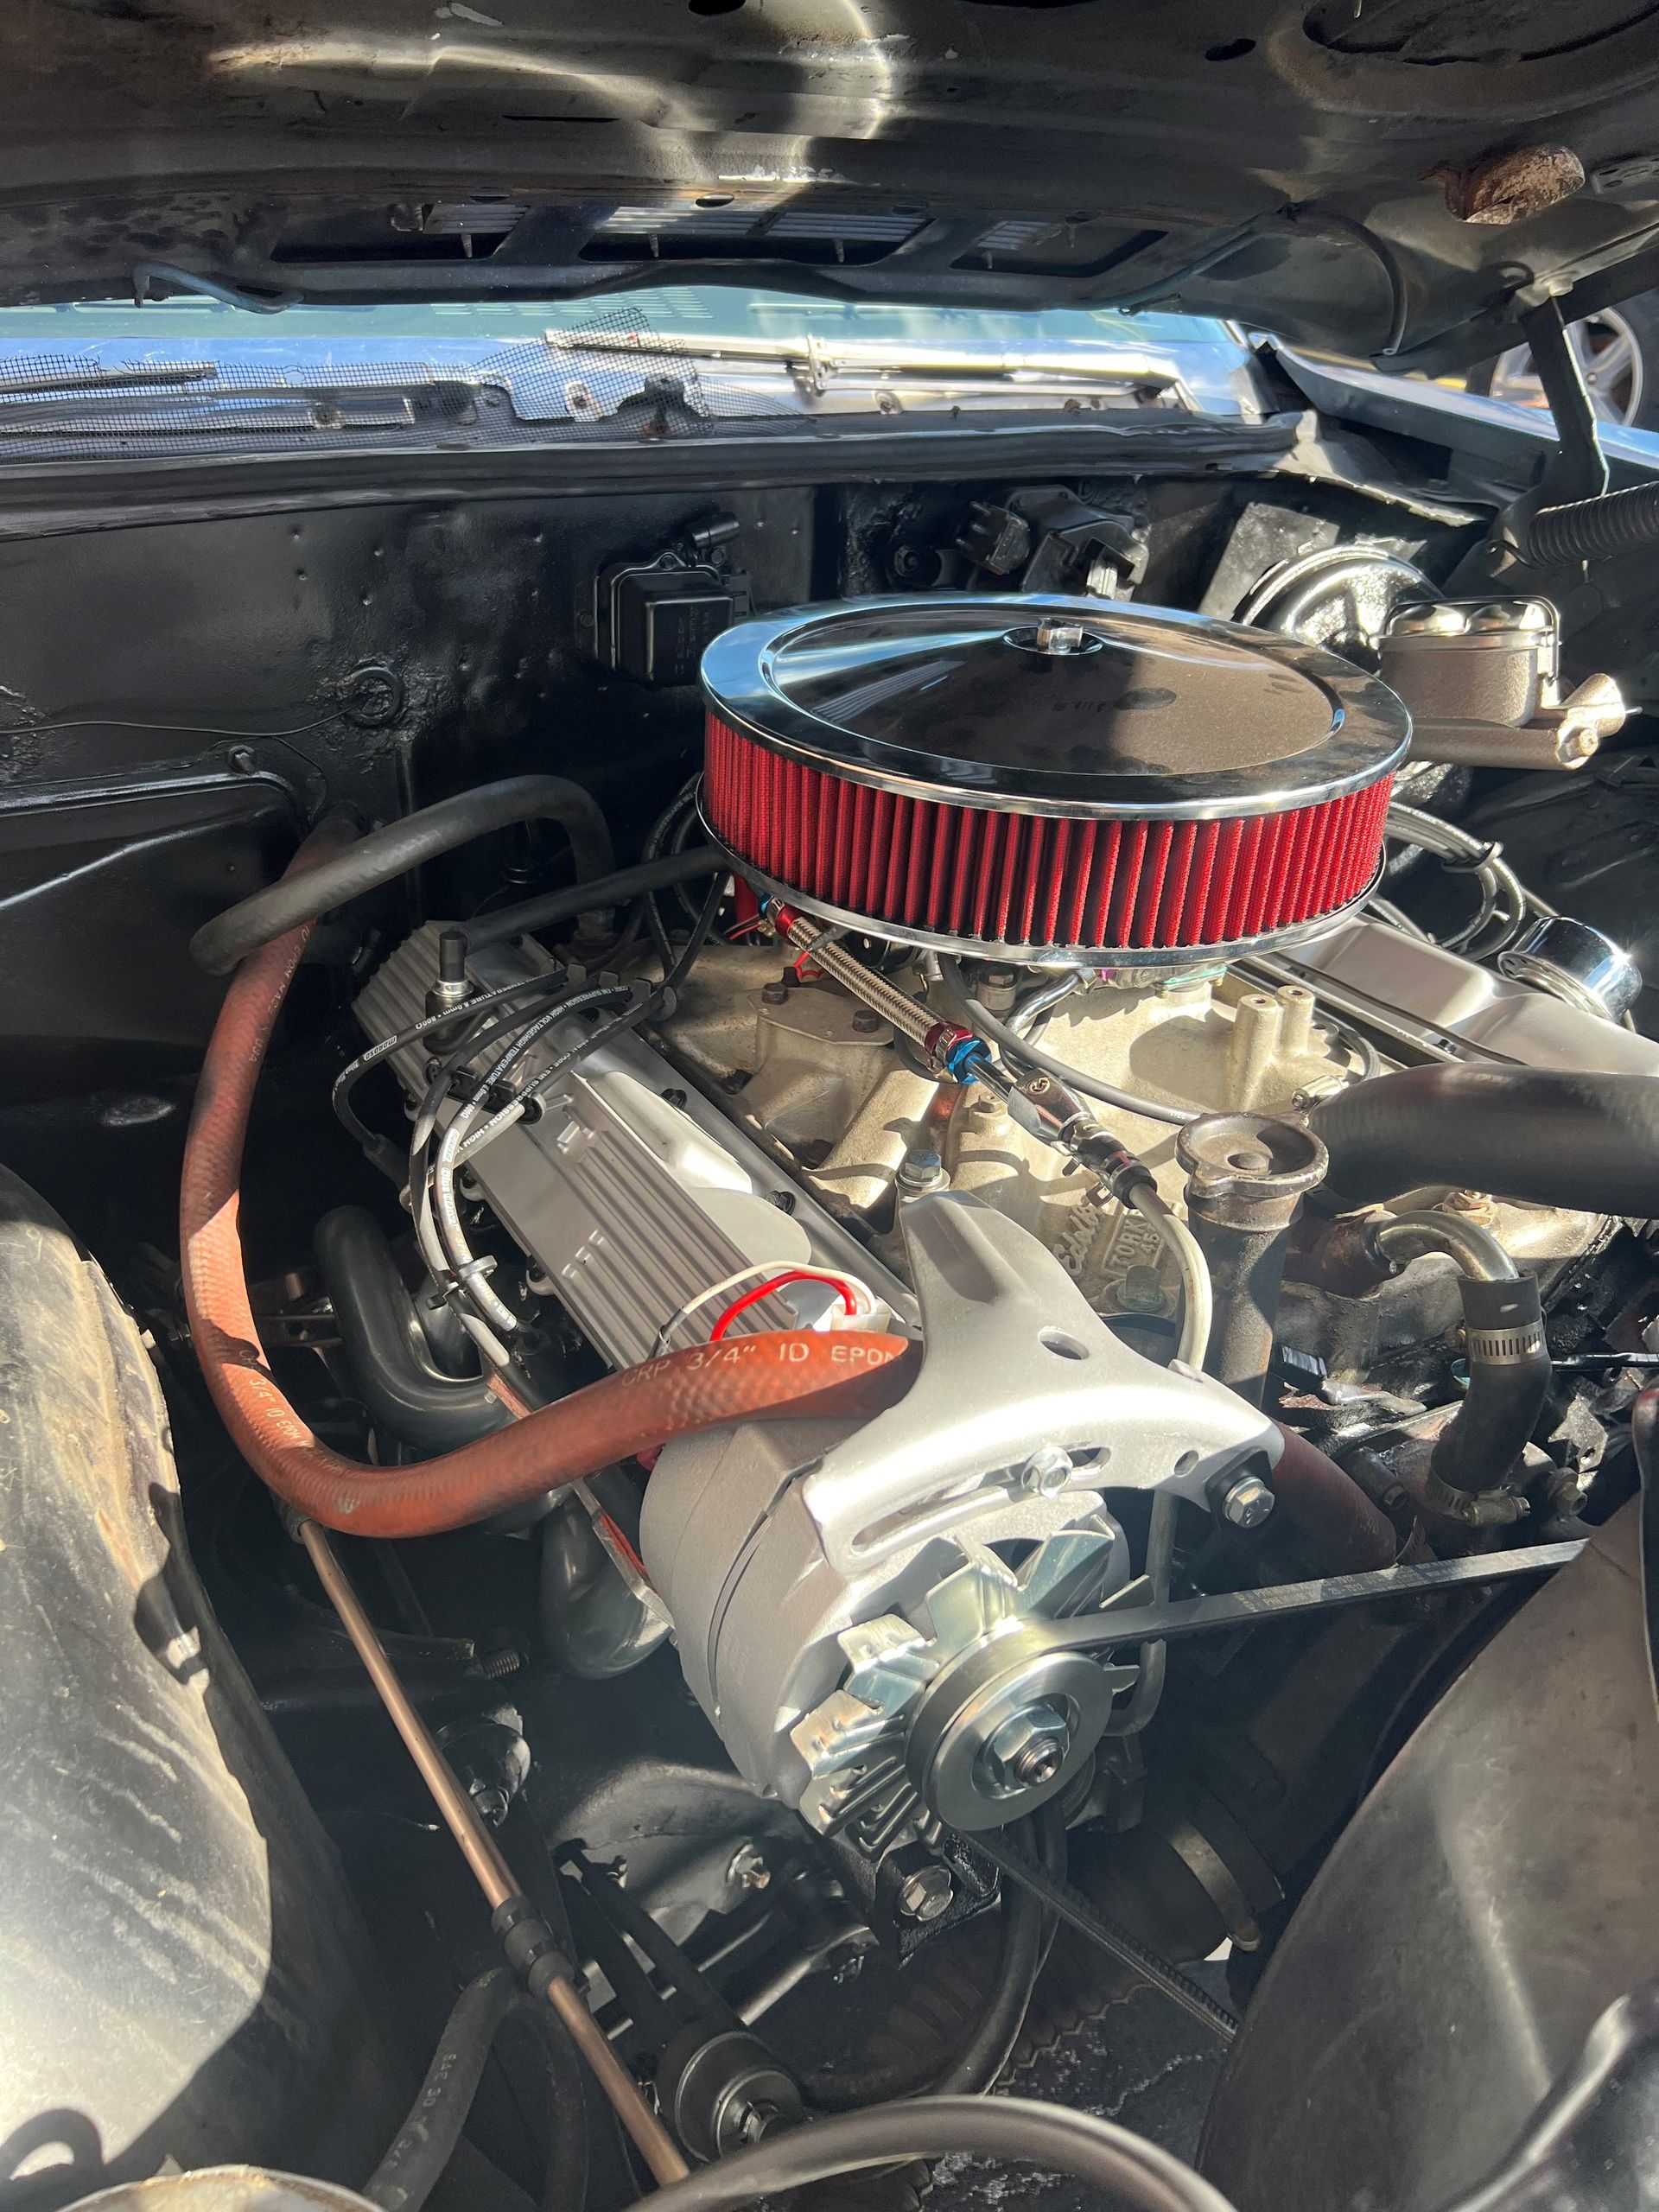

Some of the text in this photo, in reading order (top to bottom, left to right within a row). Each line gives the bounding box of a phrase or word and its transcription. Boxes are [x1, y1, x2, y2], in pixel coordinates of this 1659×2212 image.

[566, 989, 603, 1008] SUPPRESSION
[549, 1005, 565, 1018] HIGH
[485, 1046, 520, 1086] TEMPERATURE
[488, 1080, 540, 1127] SUPPRESSION
[462, 1129, 486, 1147] HIGH
[779, 1342, 810, 1363] ID
[265, 1407, 286, 1418] ID
[276, 1420, 302, 1440] EPDM
